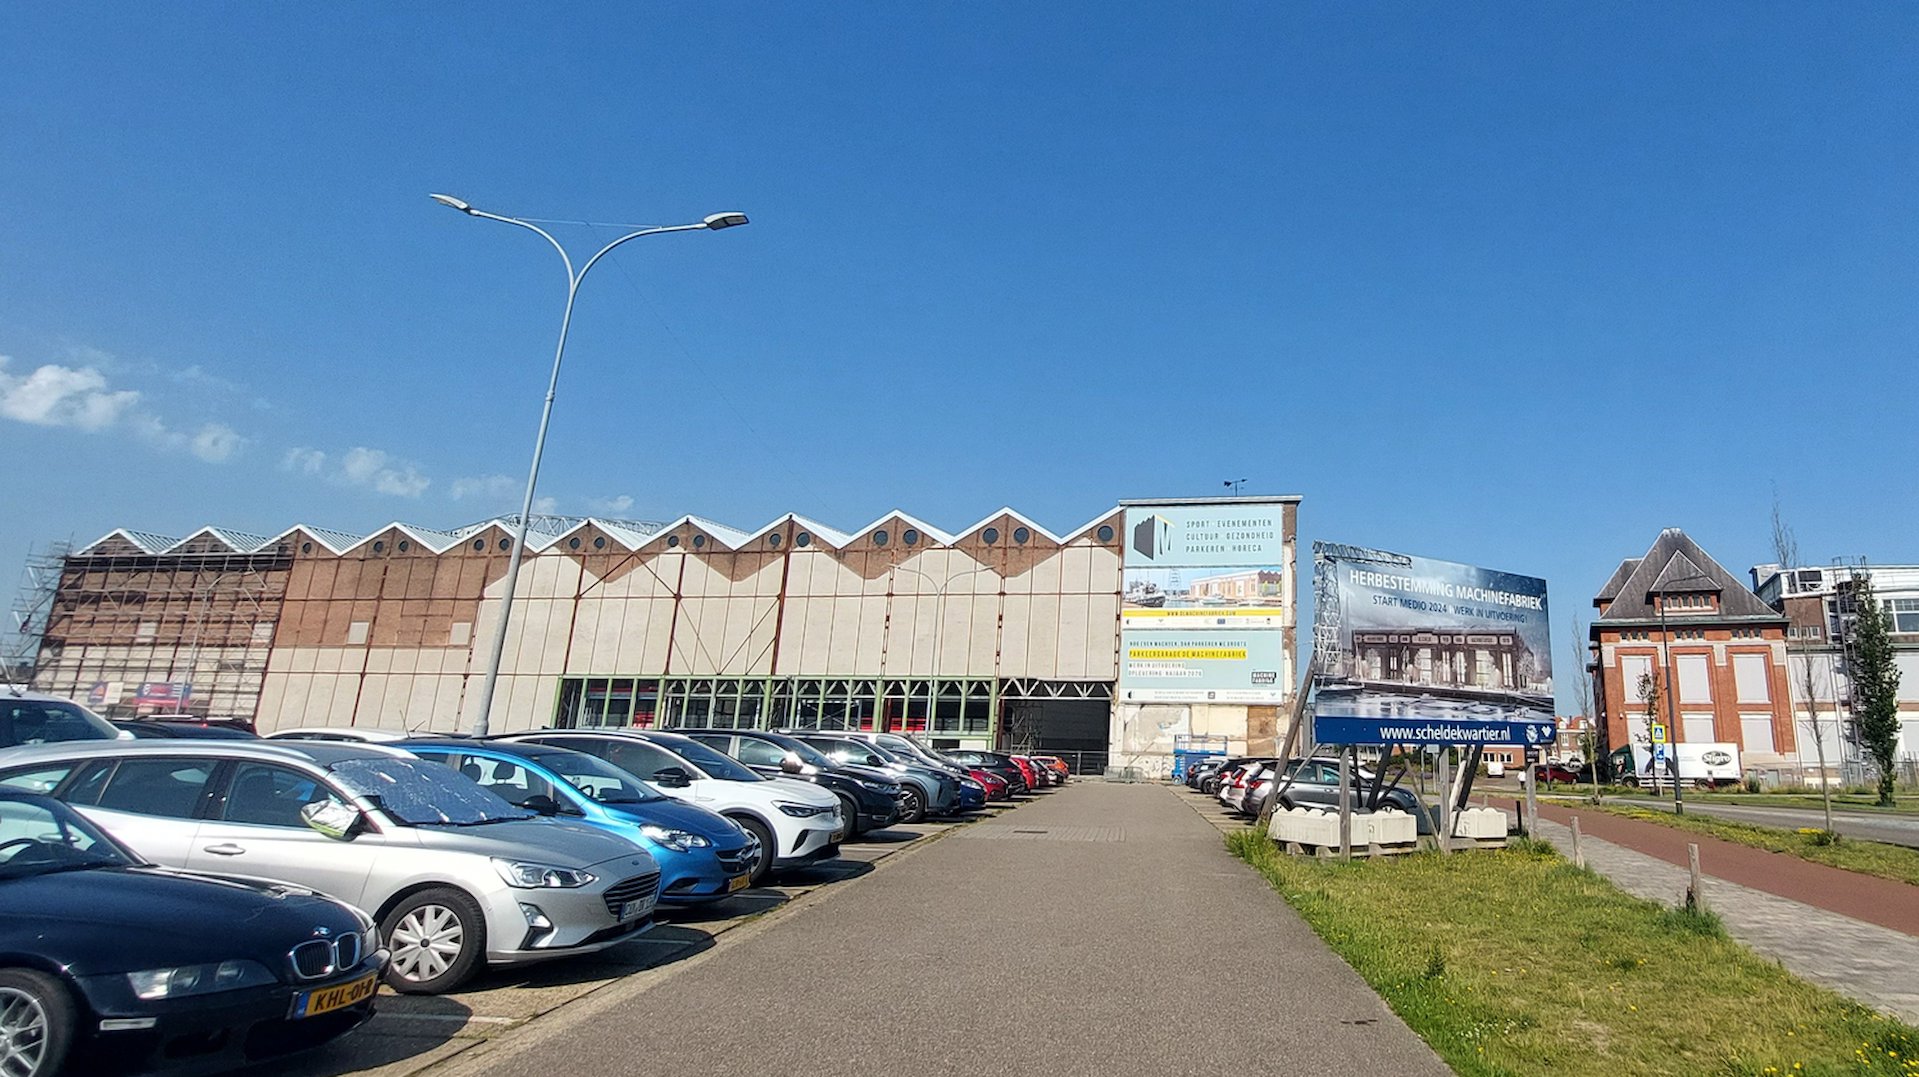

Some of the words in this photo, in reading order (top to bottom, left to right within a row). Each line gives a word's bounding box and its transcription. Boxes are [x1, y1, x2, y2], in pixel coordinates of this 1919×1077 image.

[1186, 520, 1210, 529] SPORT
[1217, 519, 1272, 528] EVENEMENTEN
[1186, 533, 1219, 541] CULTUUR
[1226, 532, 1274, 540] GEZONDHEID
[1186, 545, 1225, 553] PARKEREN
[1232, 544, 1262, 552] HORECA
[1350, 569, 1453, 597] HERBESTEMMING
[1456, 584, 1543, 611] MACHINEFABRIEK
[1372, 594, 1398, 607] START
[1400, 598, 1426, 611] MEDIO
[1428, 602, 1447, 613] 2024
[1454, 605, 1475, 617] WERK
[1476, 608, 1484, 618] IN
[1380, 724, 1511, 741] www.scheldekwartier.nl
[1703, 753, 1730, 765] Sligro
